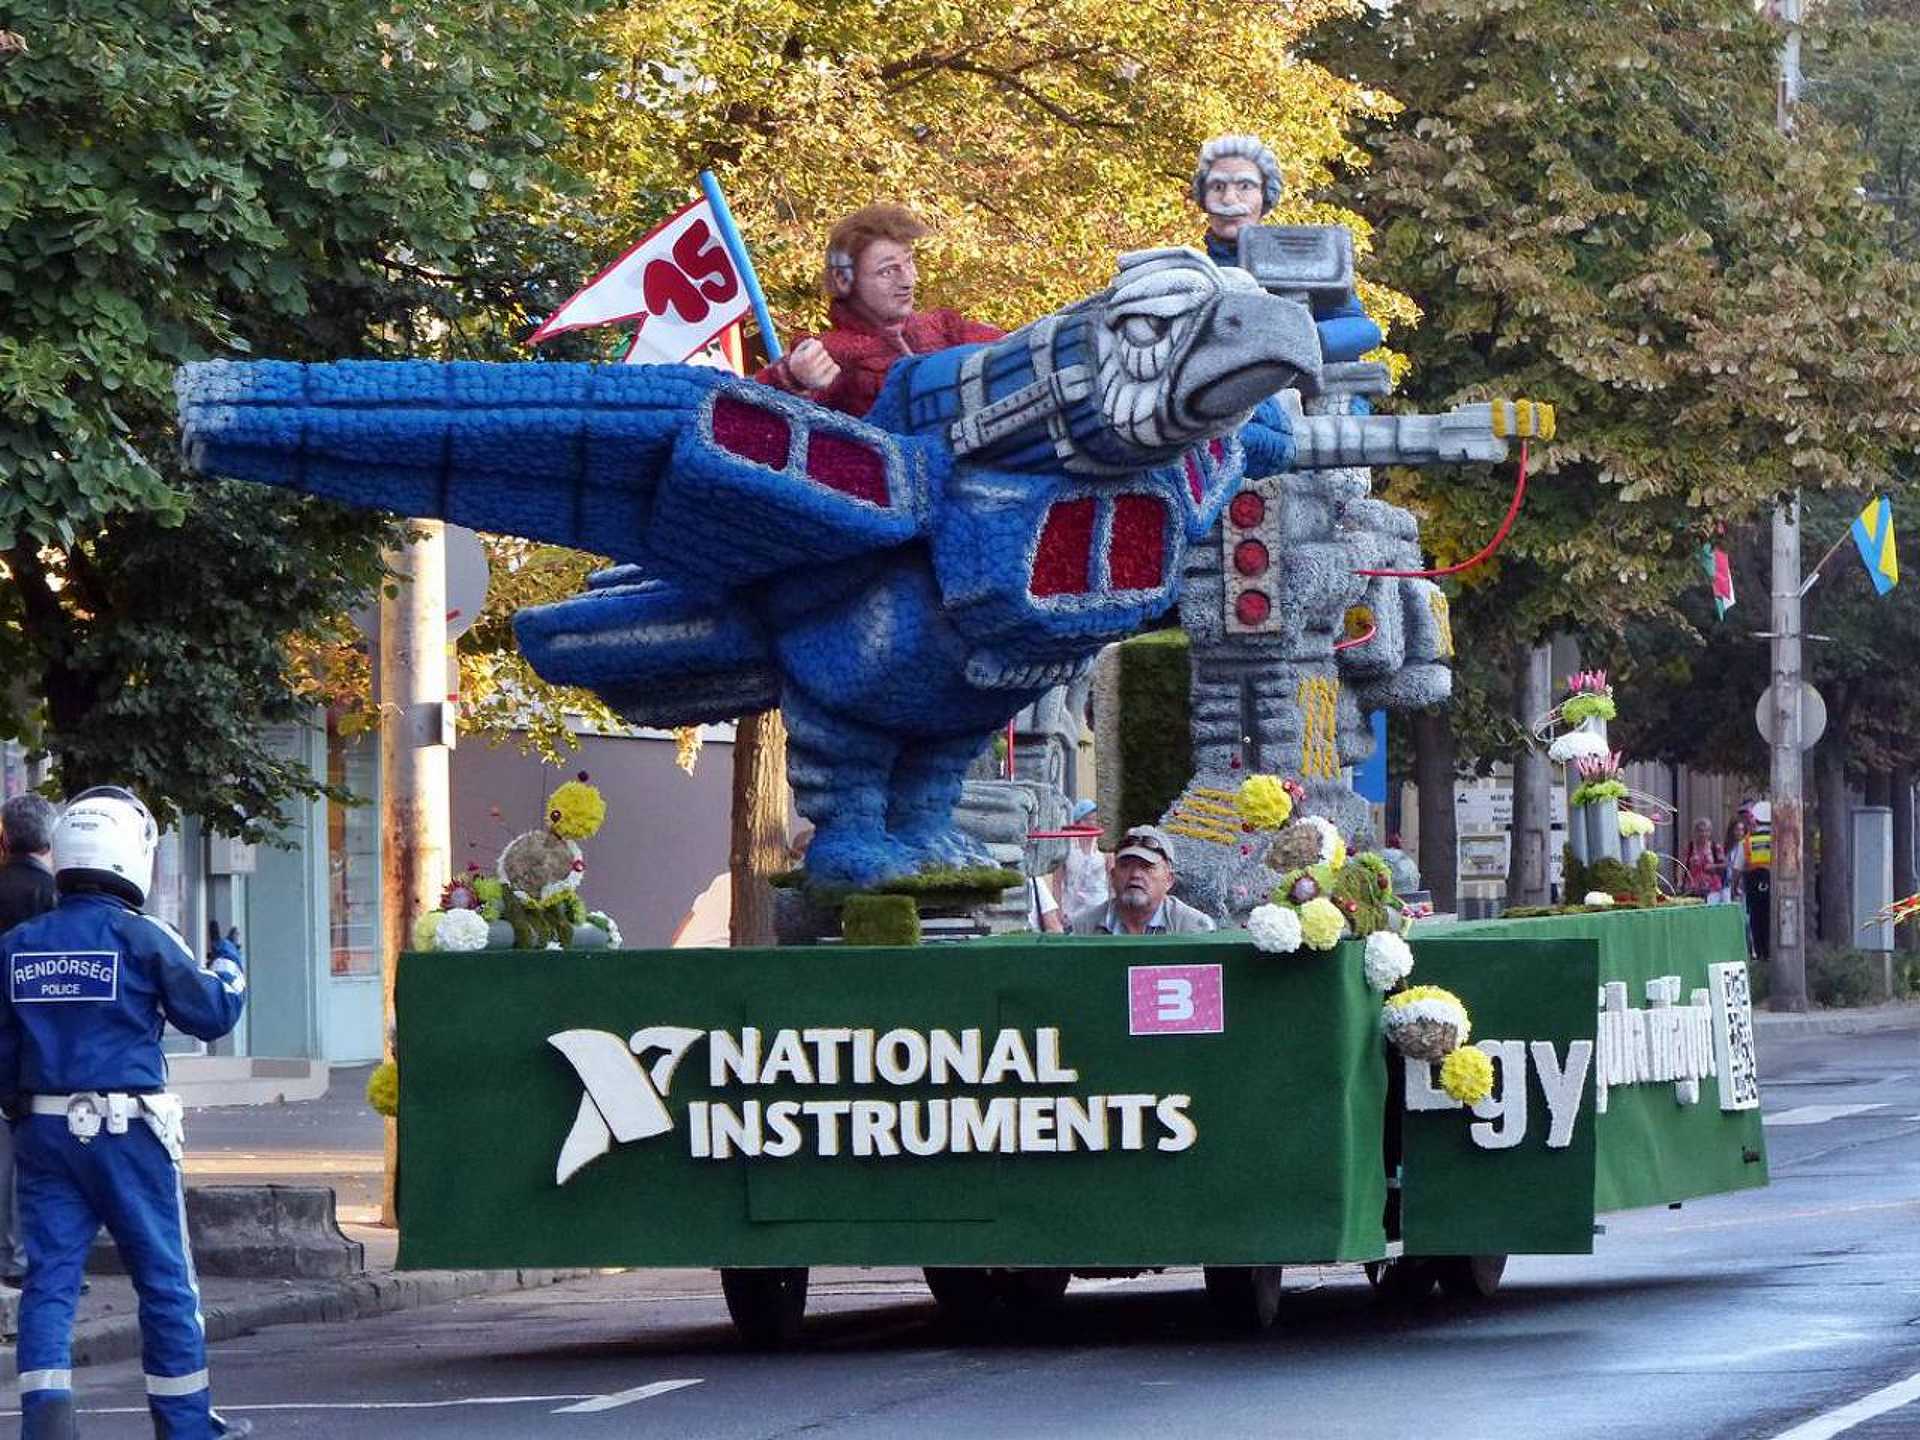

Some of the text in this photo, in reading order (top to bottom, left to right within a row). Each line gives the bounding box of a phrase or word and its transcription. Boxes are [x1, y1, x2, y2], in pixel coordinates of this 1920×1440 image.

[14, 956, 113, 984] RENDŐRSÉG
[41, 983, 81, 995] POLICE
[1157, 978, 1194, 1022] 3
[709, 1026, 1078, 1087] NATIONAL
[688, 1094, 1197, 1158] INSTRUMENTS
